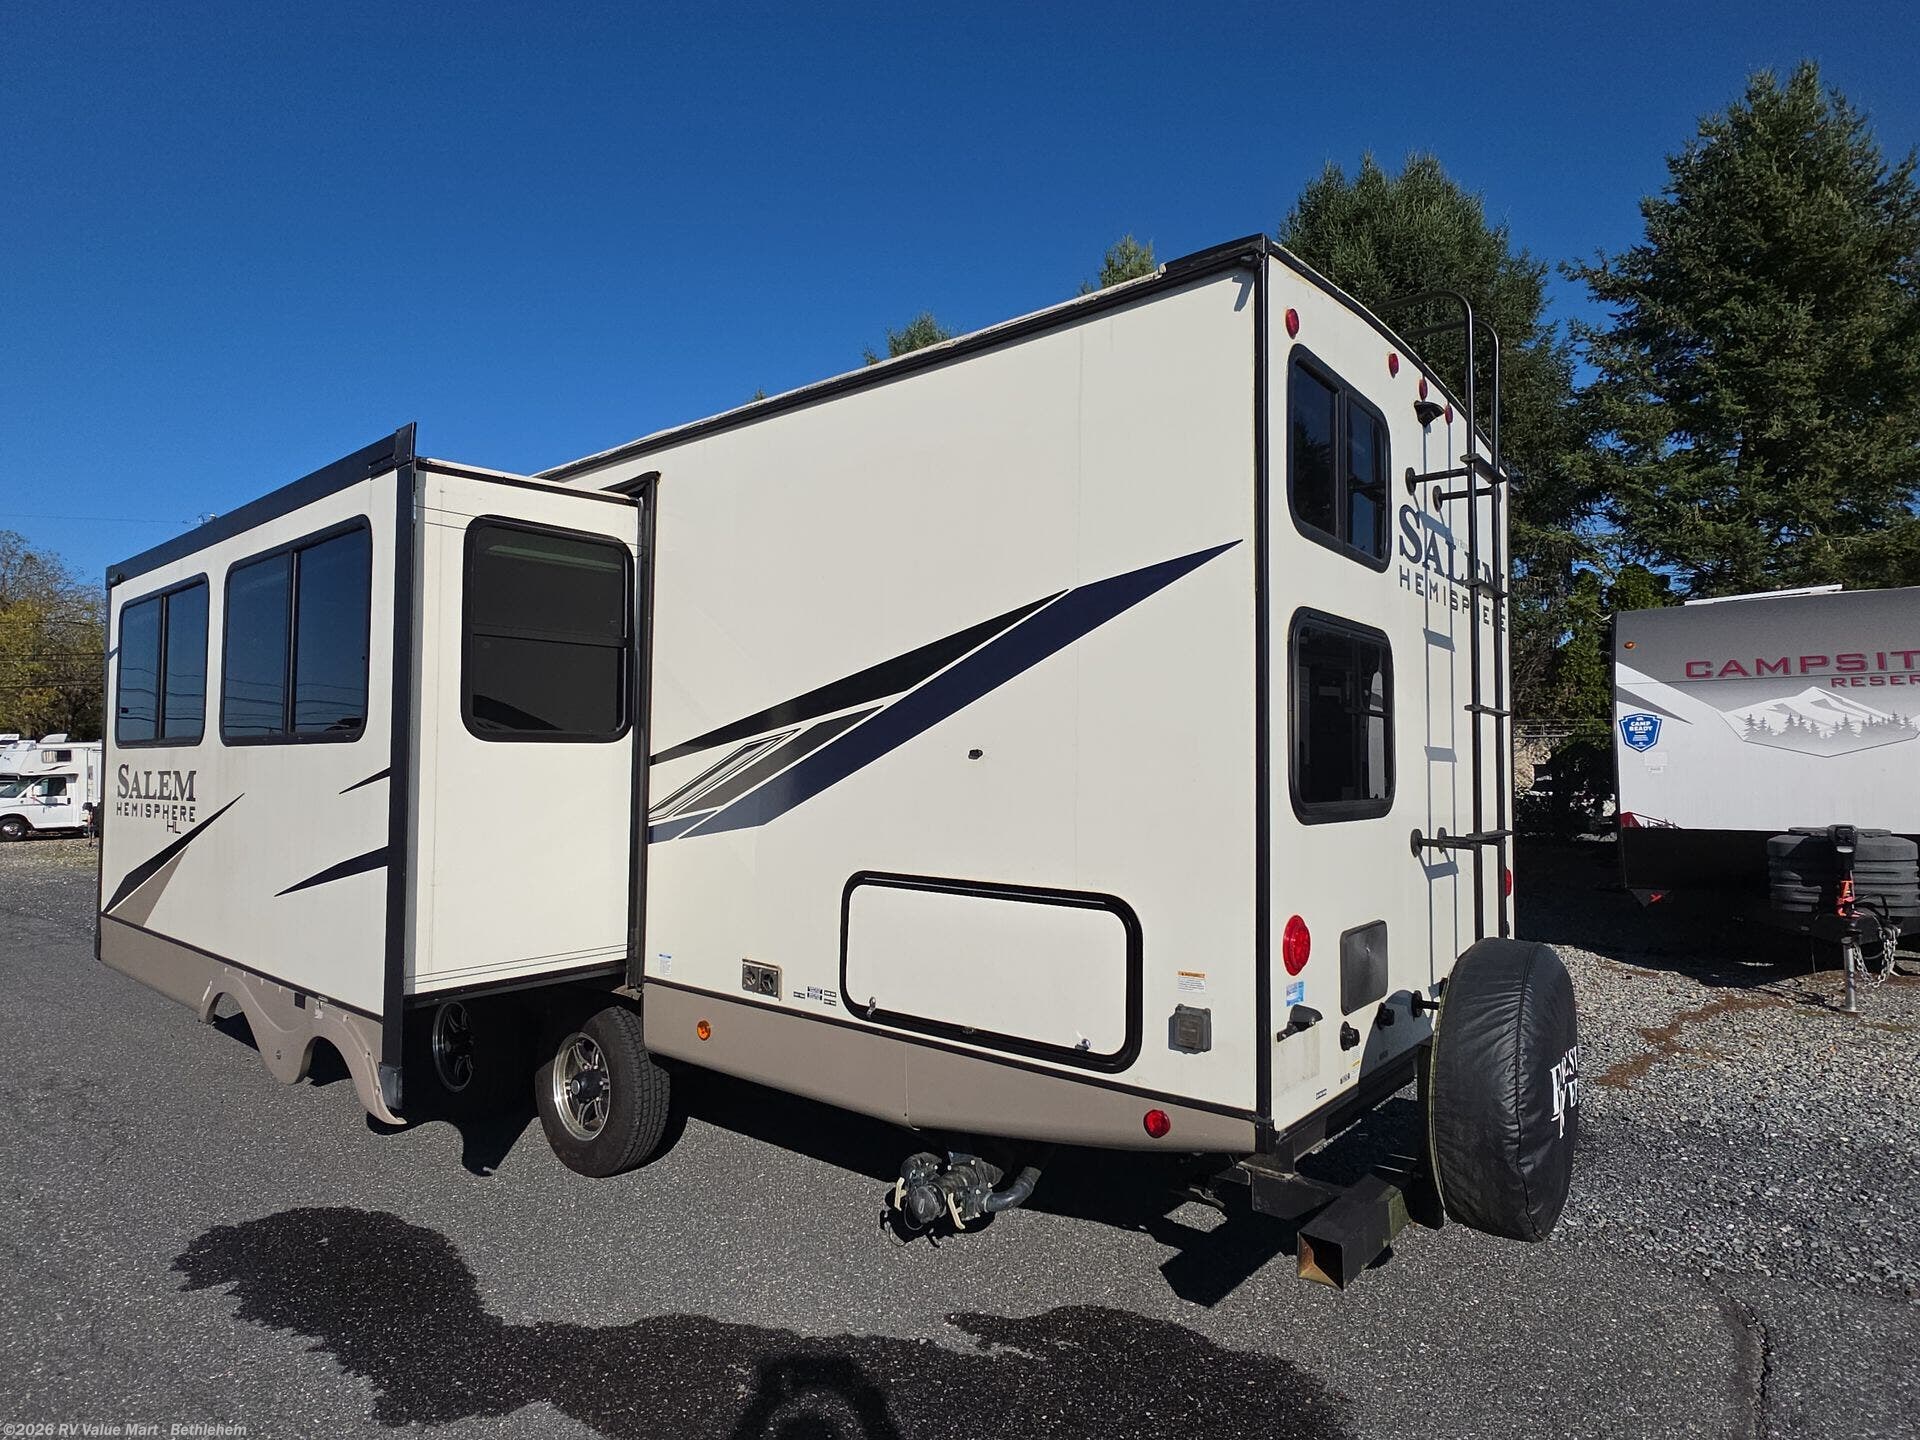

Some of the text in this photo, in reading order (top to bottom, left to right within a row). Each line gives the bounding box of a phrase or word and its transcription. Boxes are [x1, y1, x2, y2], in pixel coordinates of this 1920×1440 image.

[117, 763, 197, 802] SALEM
[116, 801, 196, 823] HEMISPHERE
[166, 820, 182, 834] HL
